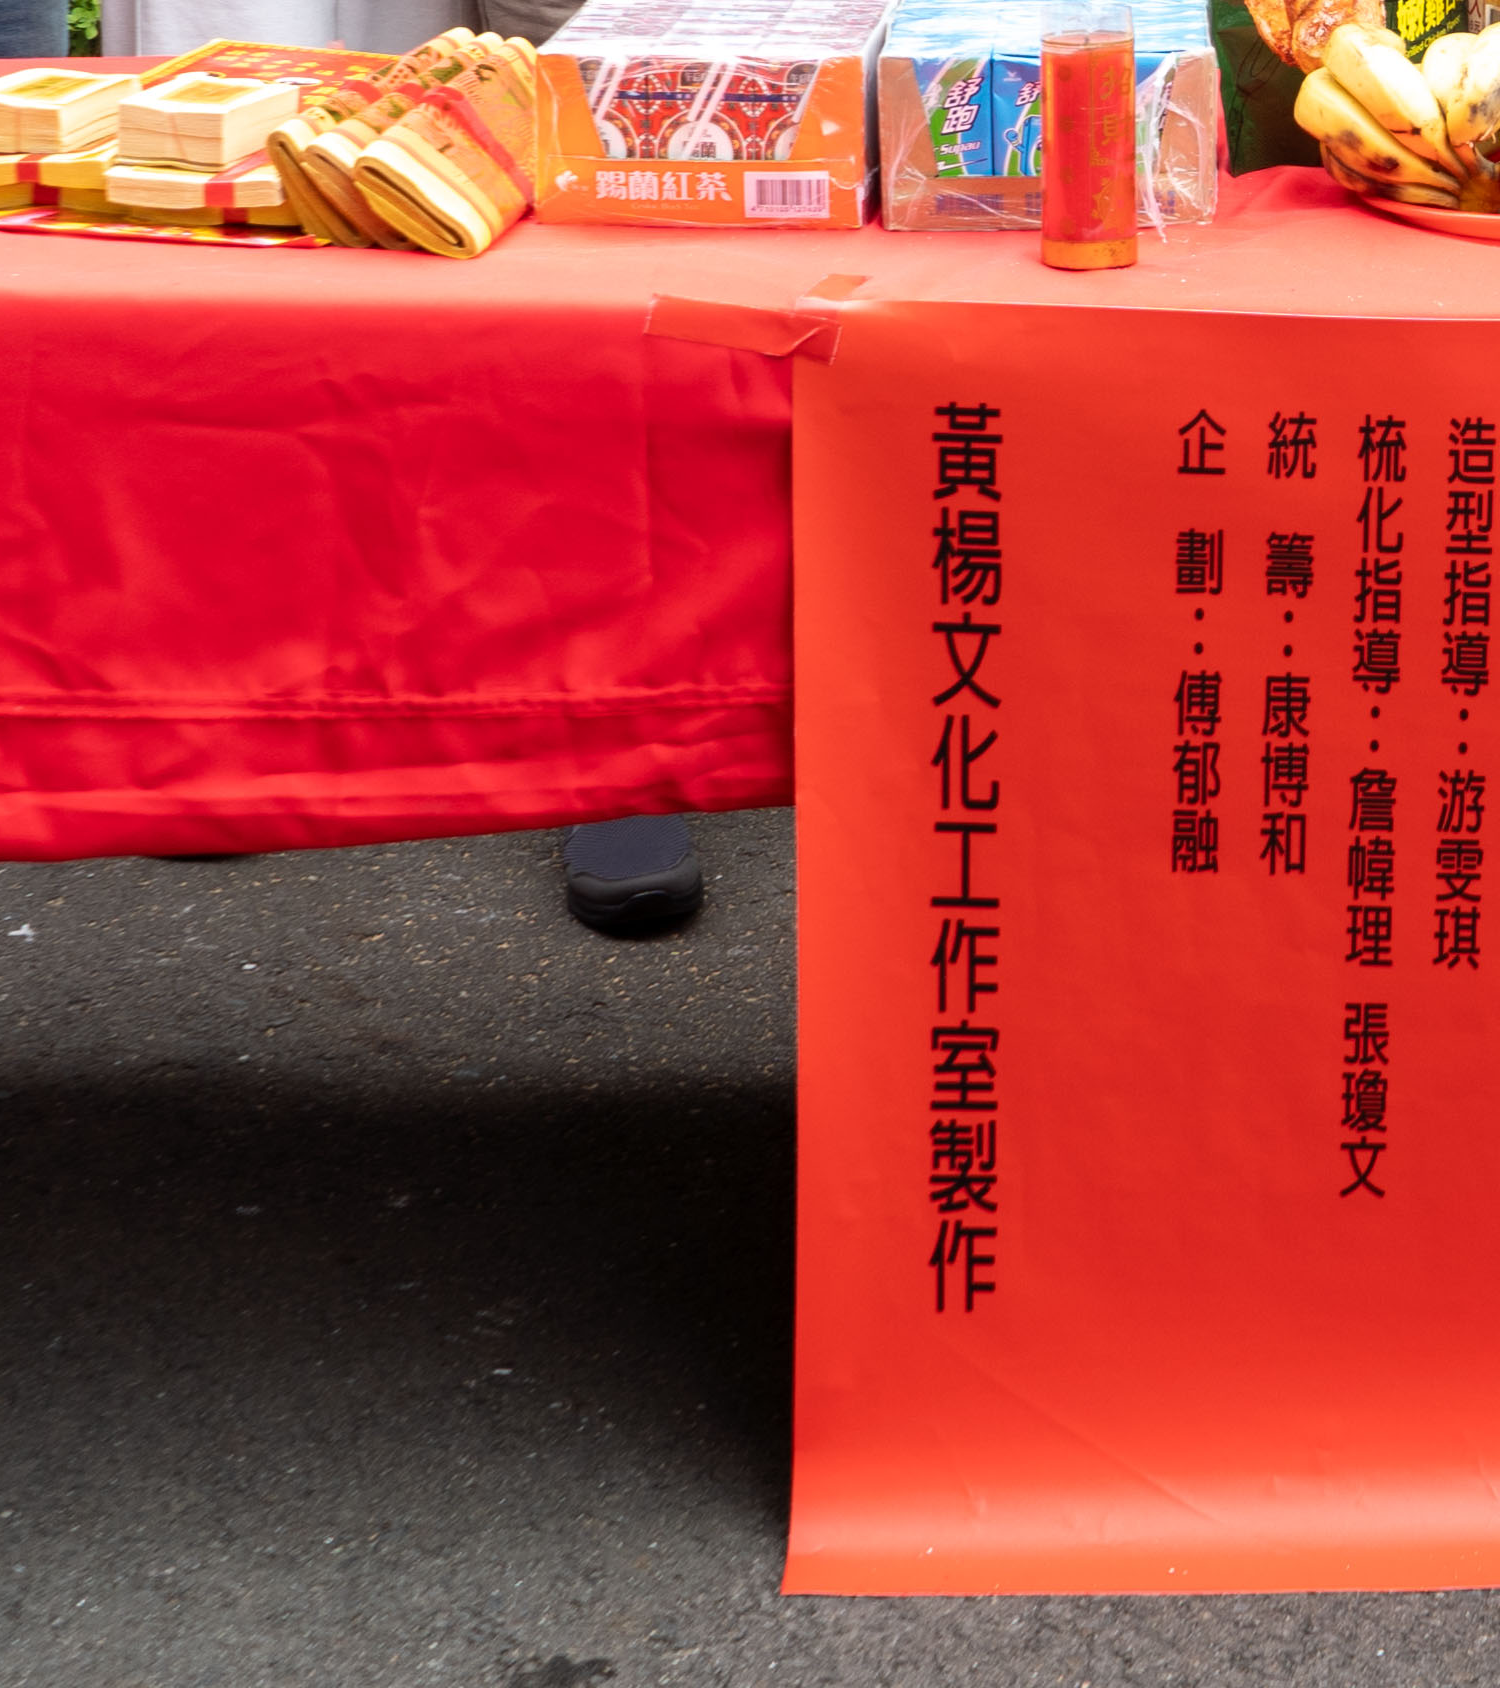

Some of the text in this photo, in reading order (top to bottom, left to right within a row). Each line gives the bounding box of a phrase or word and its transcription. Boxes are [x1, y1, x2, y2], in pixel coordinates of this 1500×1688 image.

[940, 141, 981, 155] Supau
[941, 76, 984, 135] 舒跑
[596, 170, 732, 201] 錫蘭紅茶
[1434, 417, 1496, 969] 造型指導：游雯琪
[930, 403, 1002, 1311] 黃楊文化工作室製作
[1341, 1003, 1388, 1197] 張瓊文
